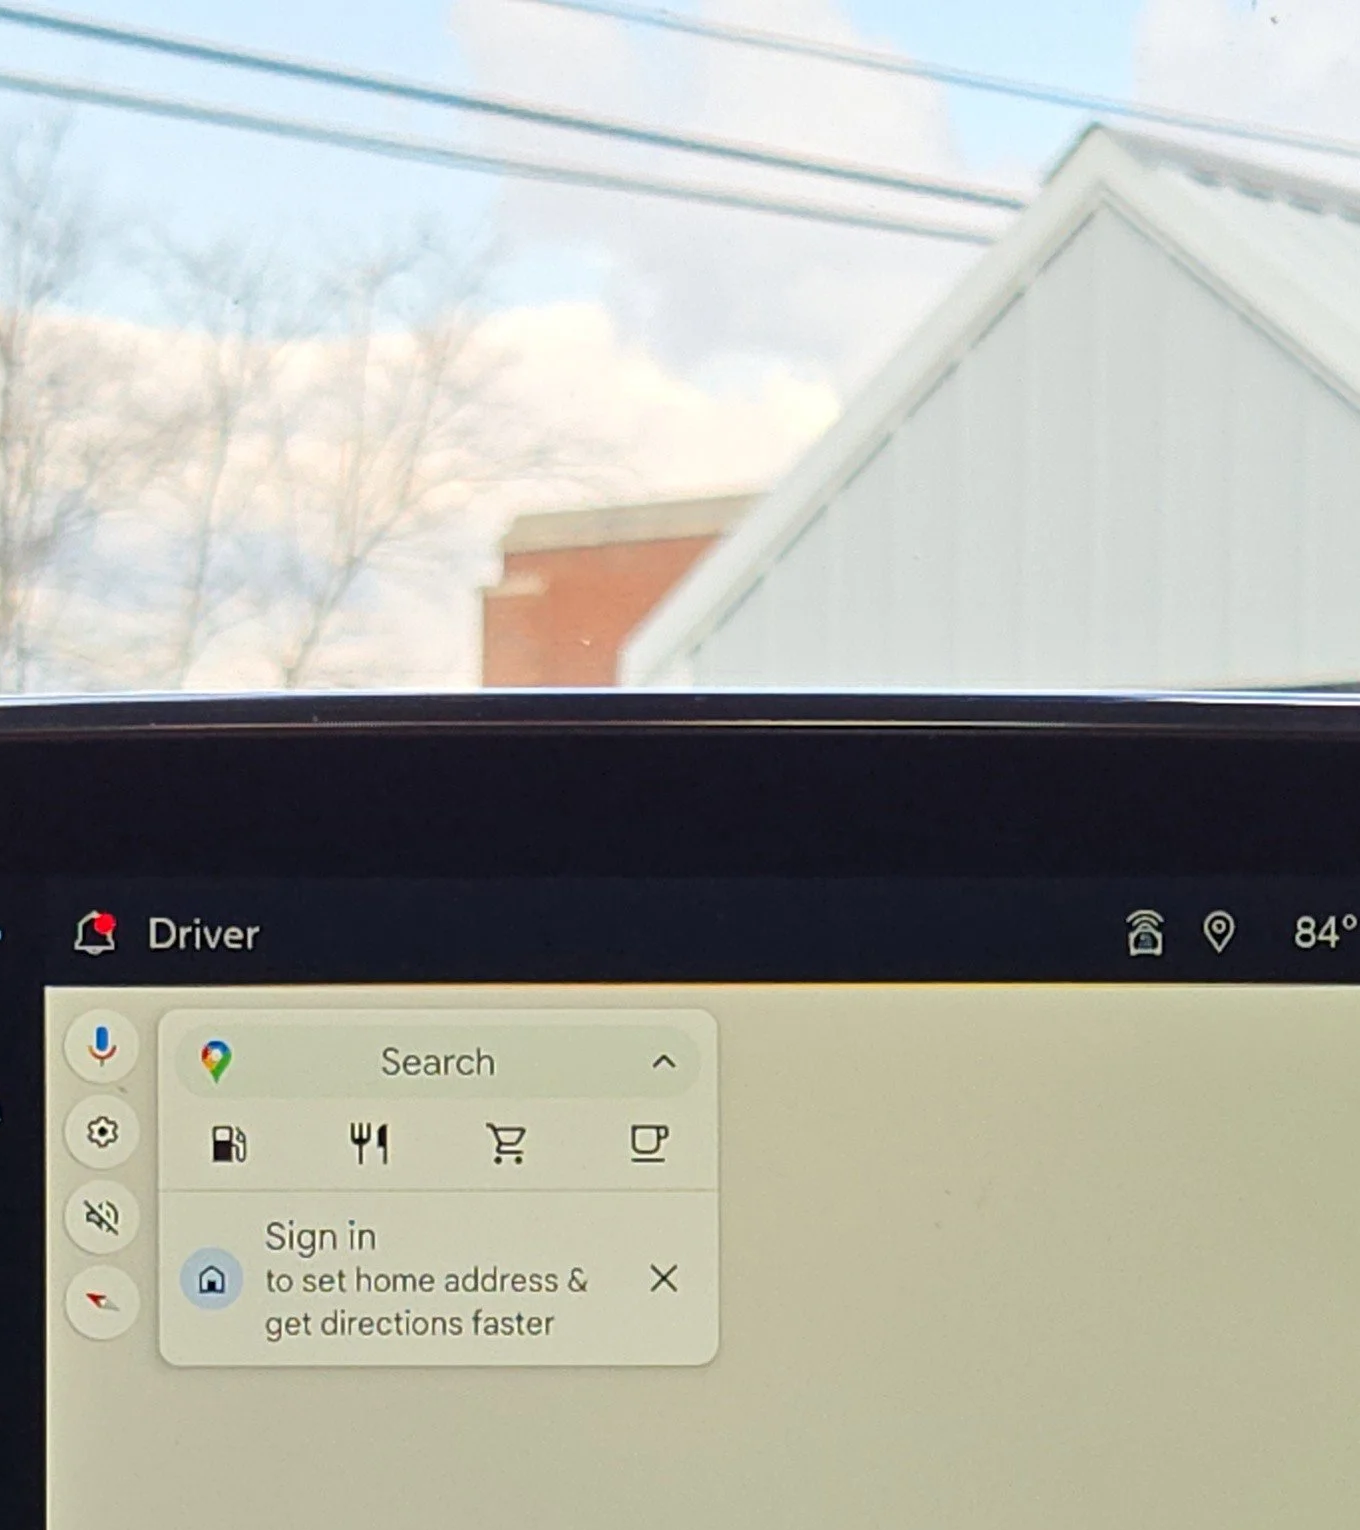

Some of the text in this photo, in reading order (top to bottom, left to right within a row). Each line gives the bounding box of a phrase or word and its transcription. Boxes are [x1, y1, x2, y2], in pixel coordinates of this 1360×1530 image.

[149, 917, 260, 950] Driver
[1294, 913, 1358, 949] 84°
[382, 1046, 495, 1076] Search
[265, 1219, 376, 1259] Sign in
[266, 1265, 588, 1293] to set home address &
[265, 1308, 555, 1343] get directions faster
